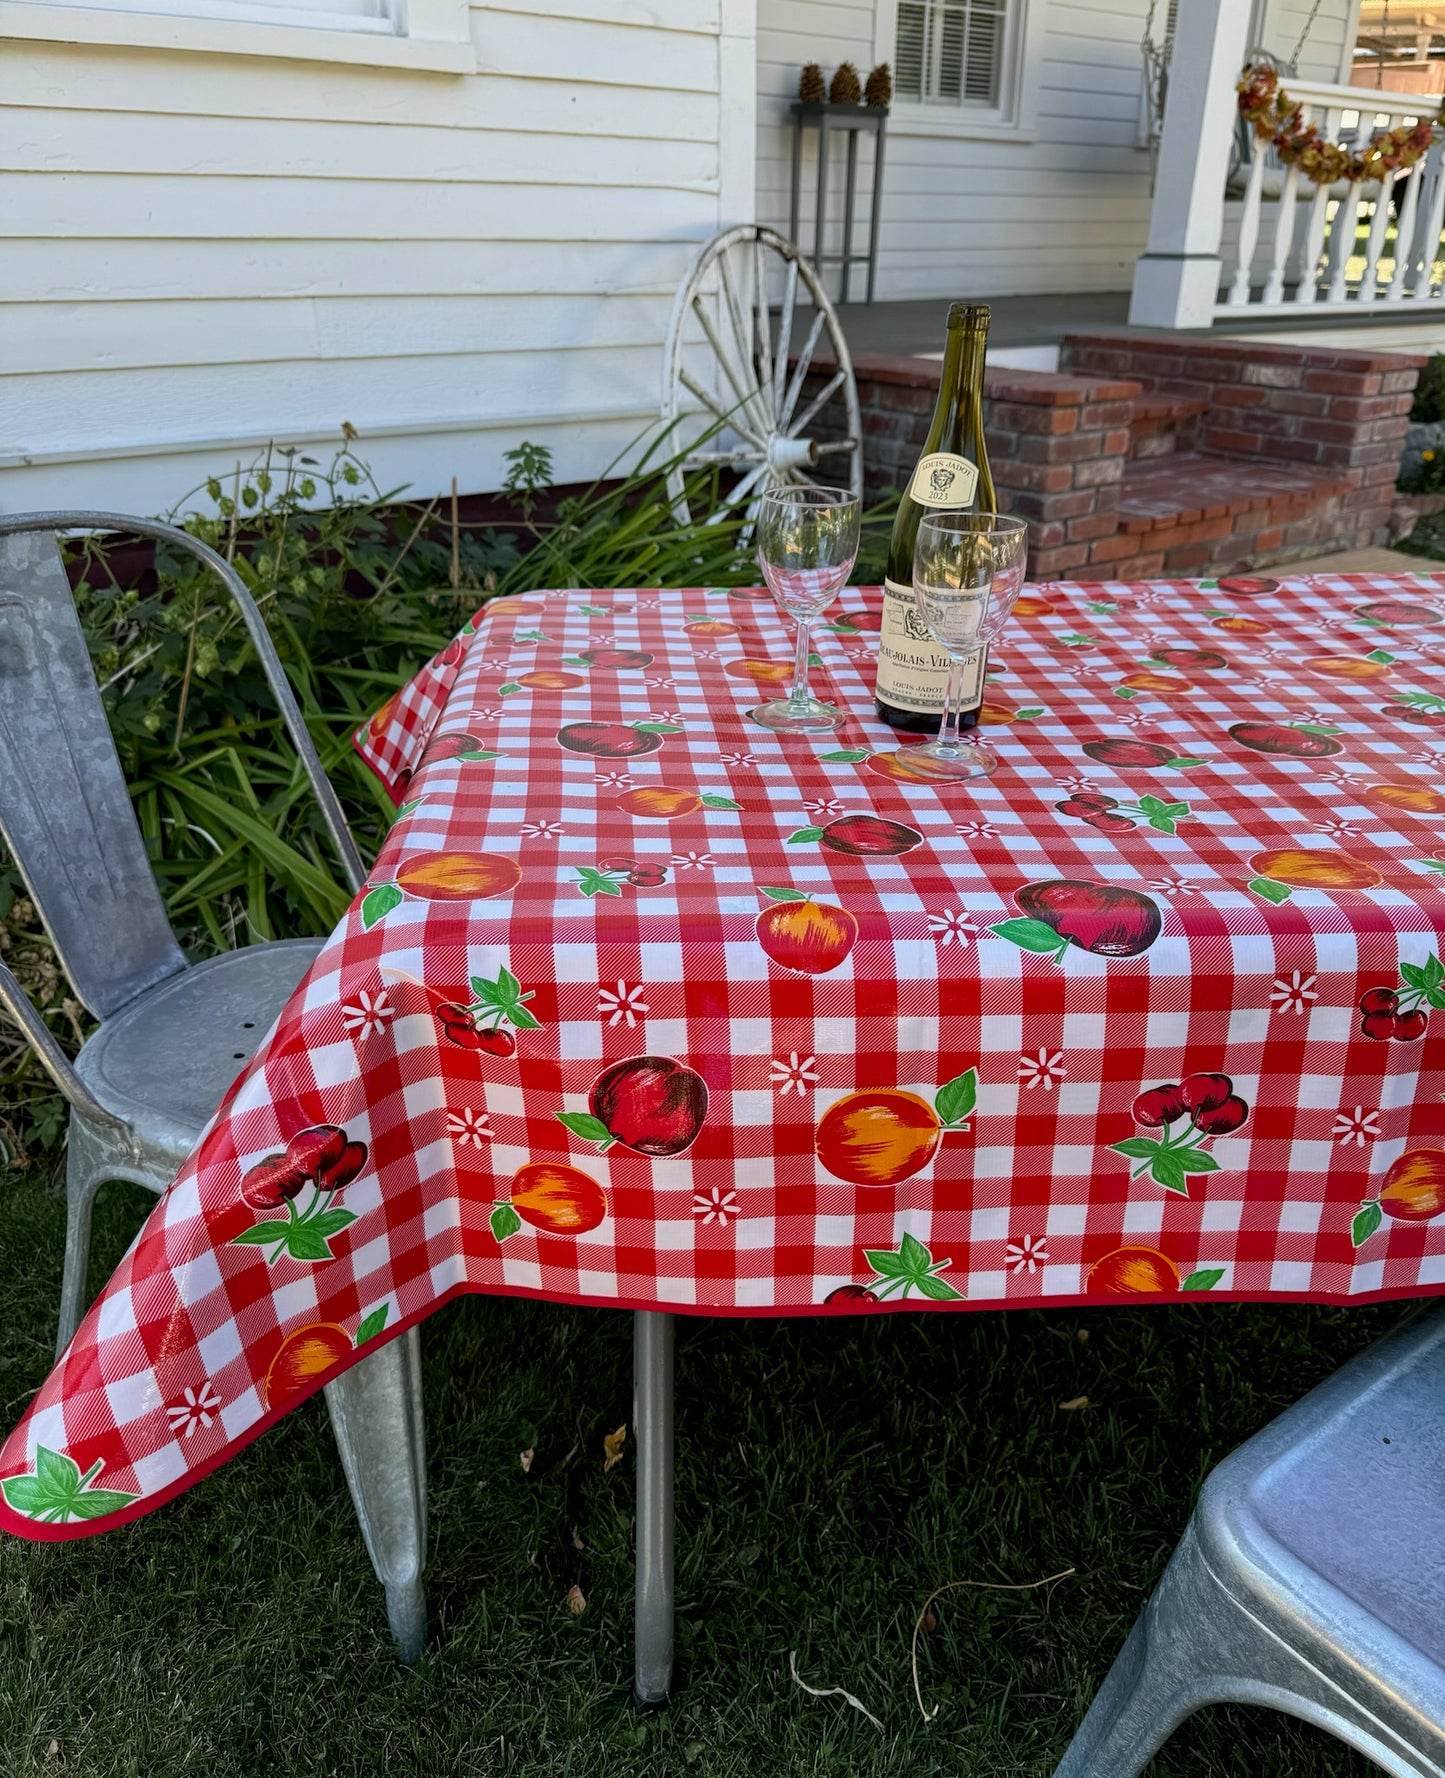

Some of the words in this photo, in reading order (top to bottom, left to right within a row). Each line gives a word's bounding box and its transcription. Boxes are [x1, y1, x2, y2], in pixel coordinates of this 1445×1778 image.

[922, 461, 944, 470] LOUIS
[945, 462, 972, 476] JADOT
[928, 491, 949, 501] 2023
[893, 680, 914, 690] LOUIS
[915, 686, 943, 694] JADOT
